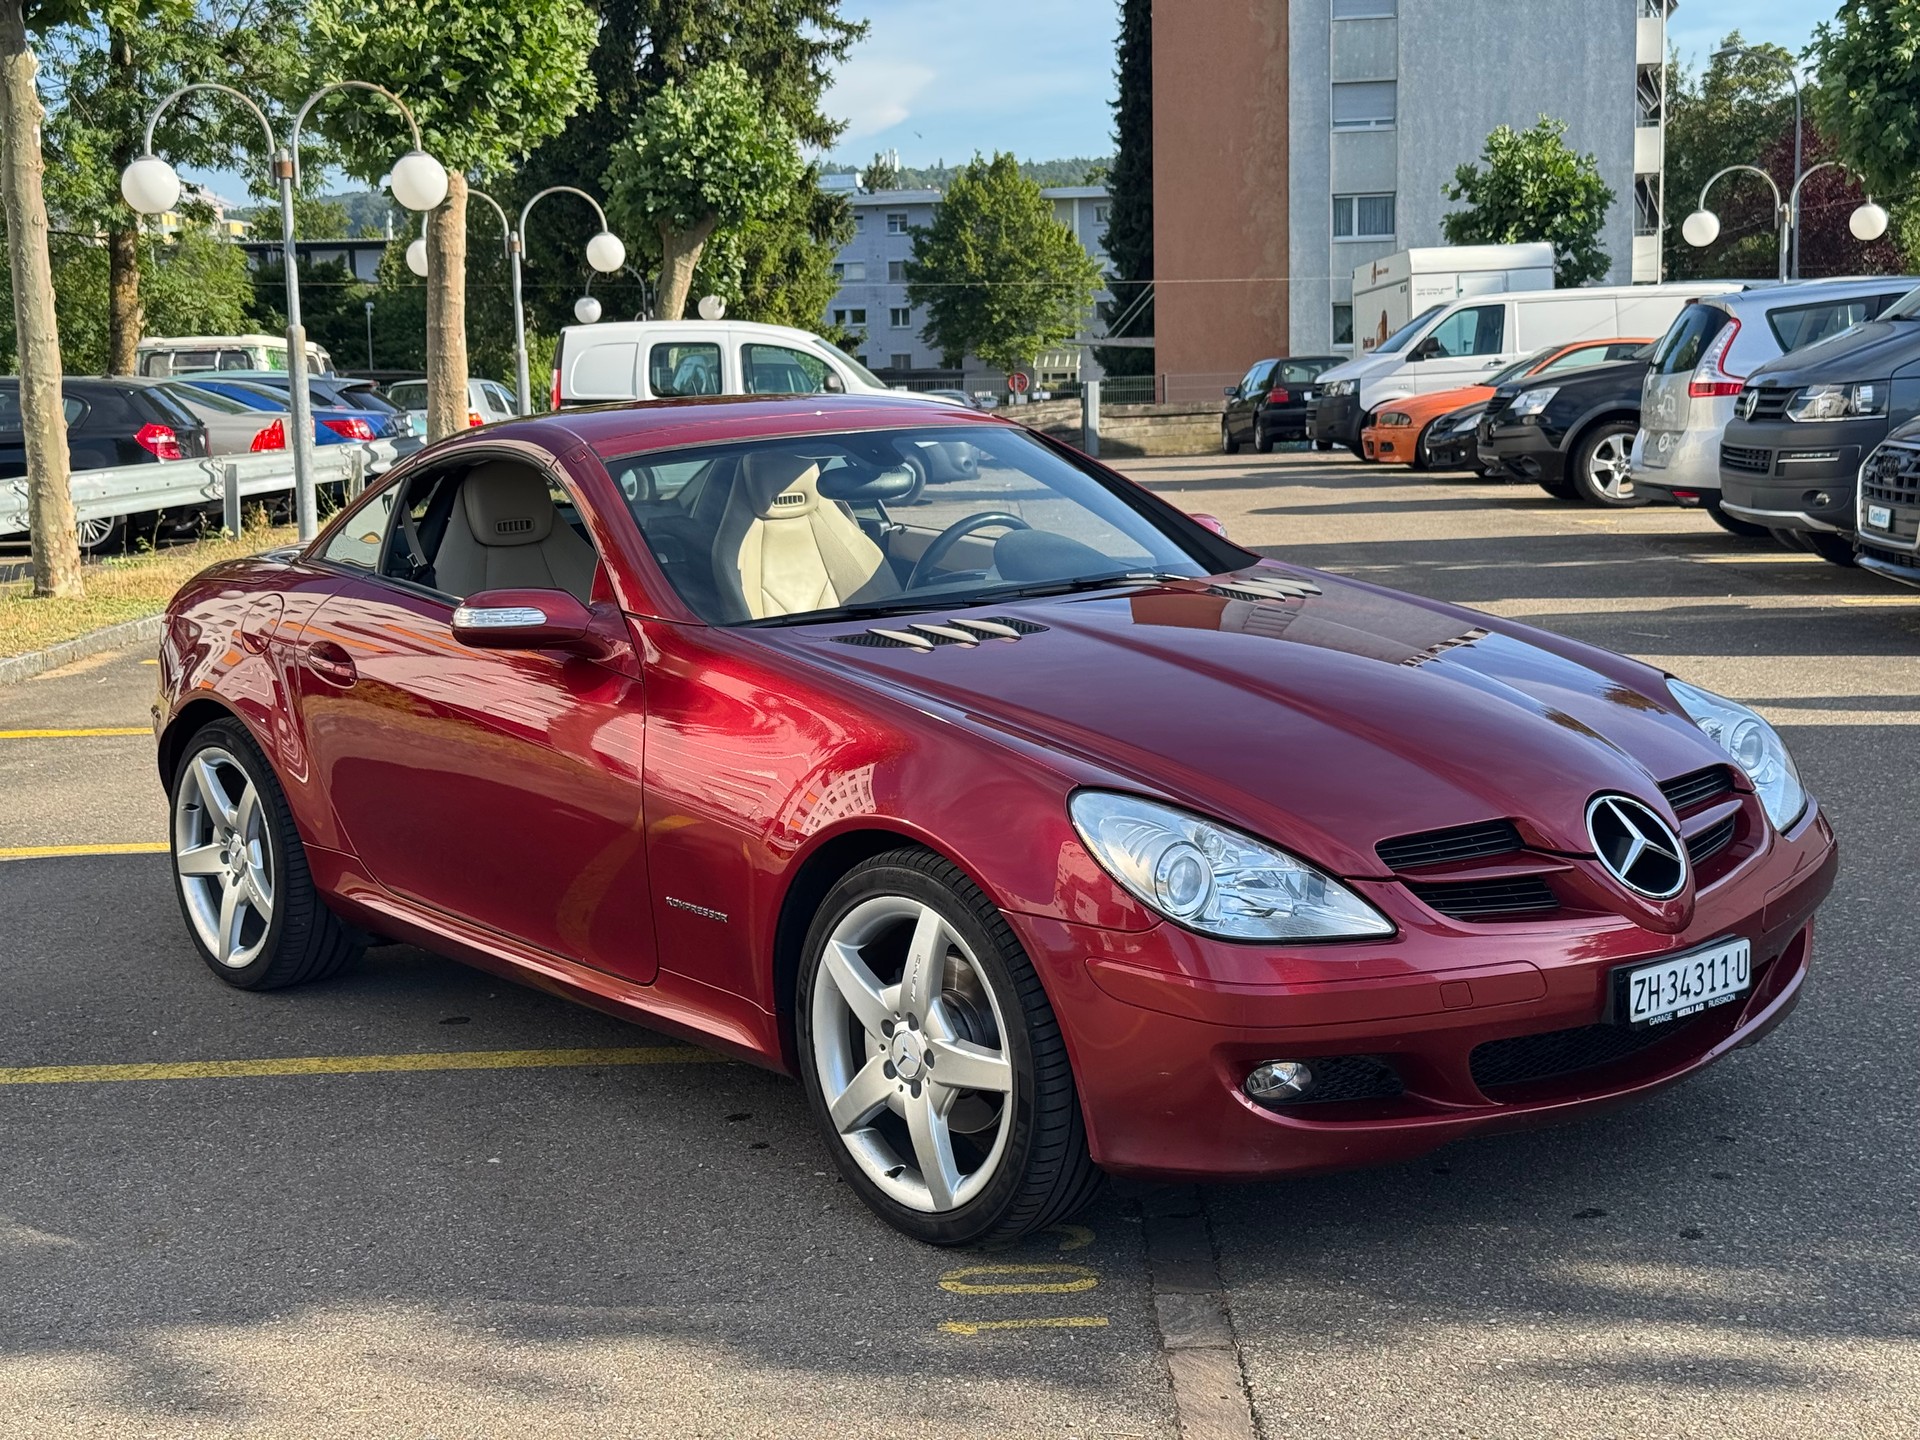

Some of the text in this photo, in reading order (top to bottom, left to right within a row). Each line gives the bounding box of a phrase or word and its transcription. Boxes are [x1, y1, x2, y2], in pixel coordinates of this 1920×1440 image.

[665, 896, 728, 923] KOMPRESSOR
[1649, 1012, 1673, 1026] GARAGE
[1695, 1003, 1704, 1012] AG
[1708, 993, 1736, 1008] RUSSIKON
